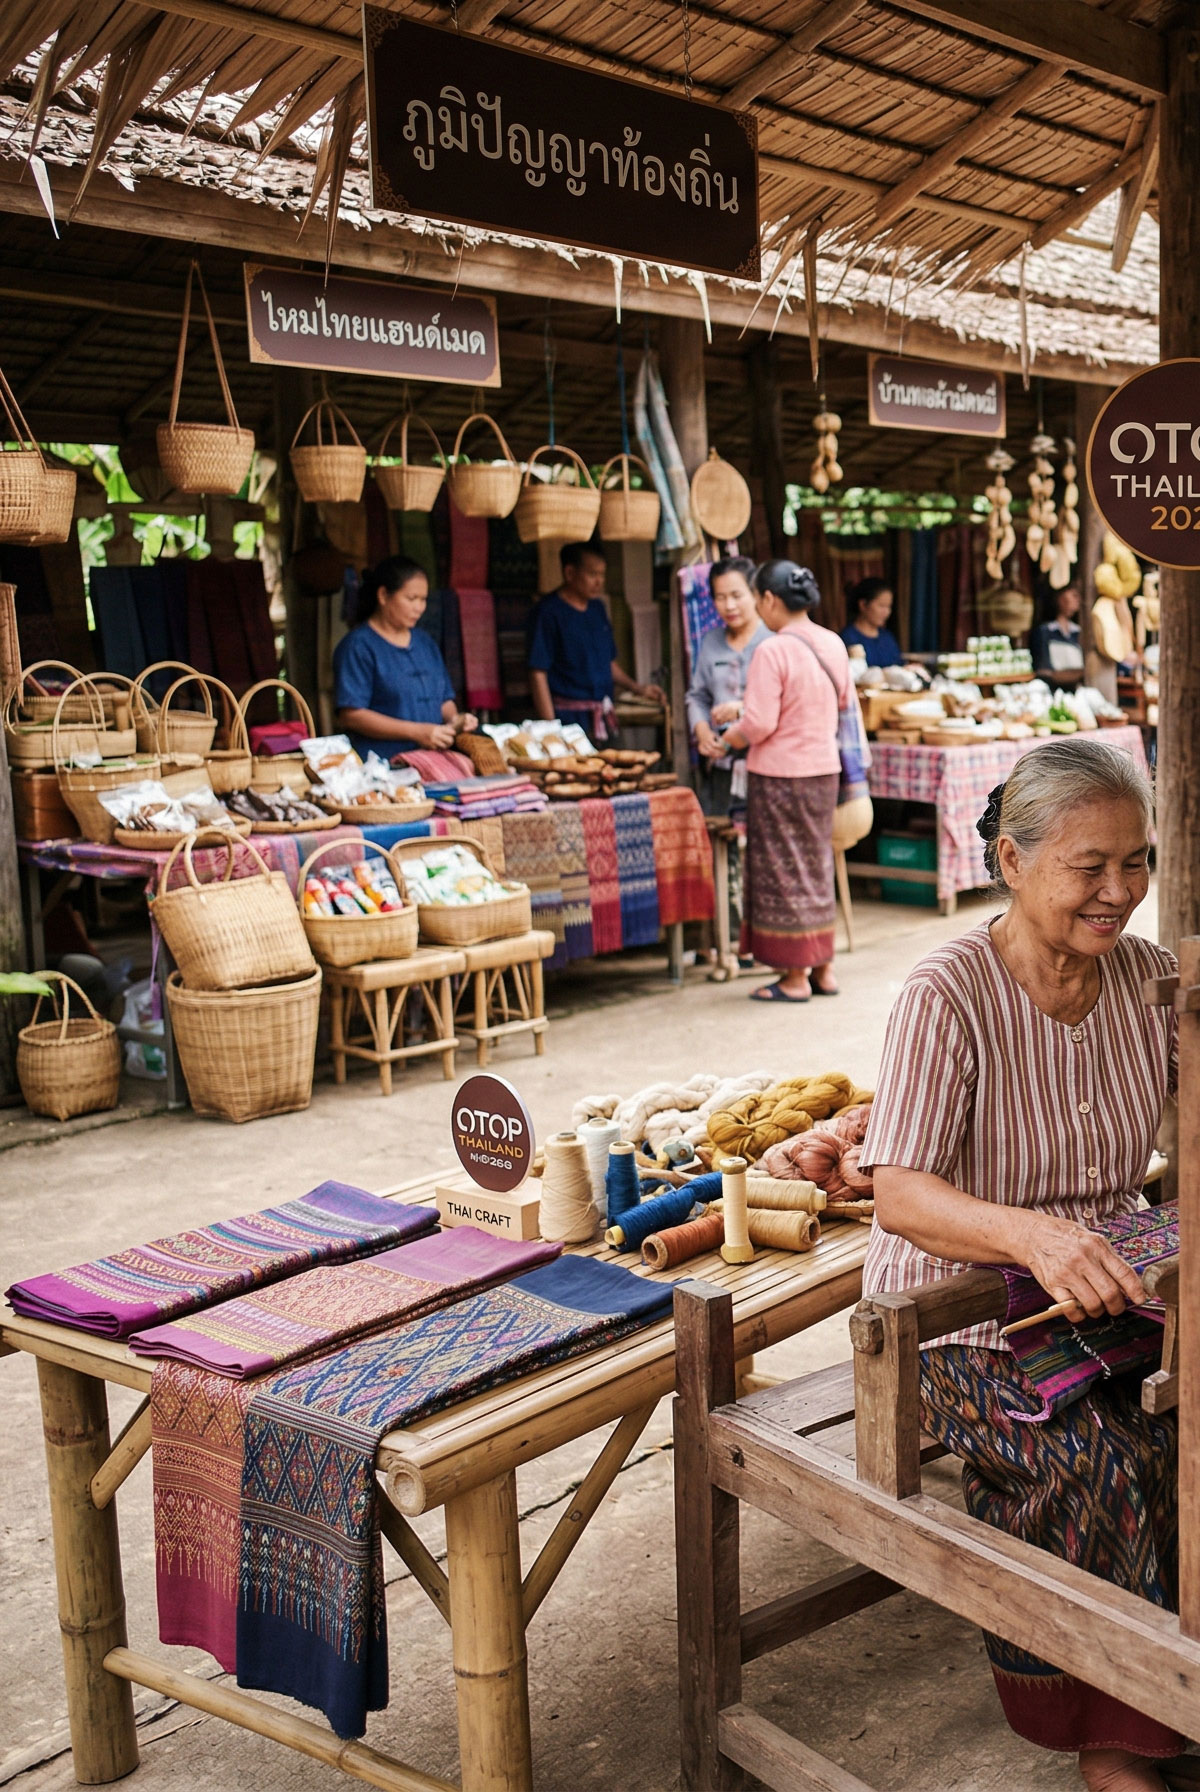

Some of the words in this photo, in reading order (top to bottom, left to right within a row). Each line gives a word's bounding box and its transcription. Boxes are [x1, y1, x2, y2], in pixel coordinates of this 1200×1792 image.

[402, 85, 740, 214] ภูมิปัญญาท้องถิ่น
[261, 289, 486, 356] ไหมไทยแฮนด์เมด
[456, 1107, 523, 1142] OTOP
[458, 1134, 524, 1159] THAILAND
[446, 1201, 472, 1219] THAI
[474, 1209, 512, 1229] CRAFT
